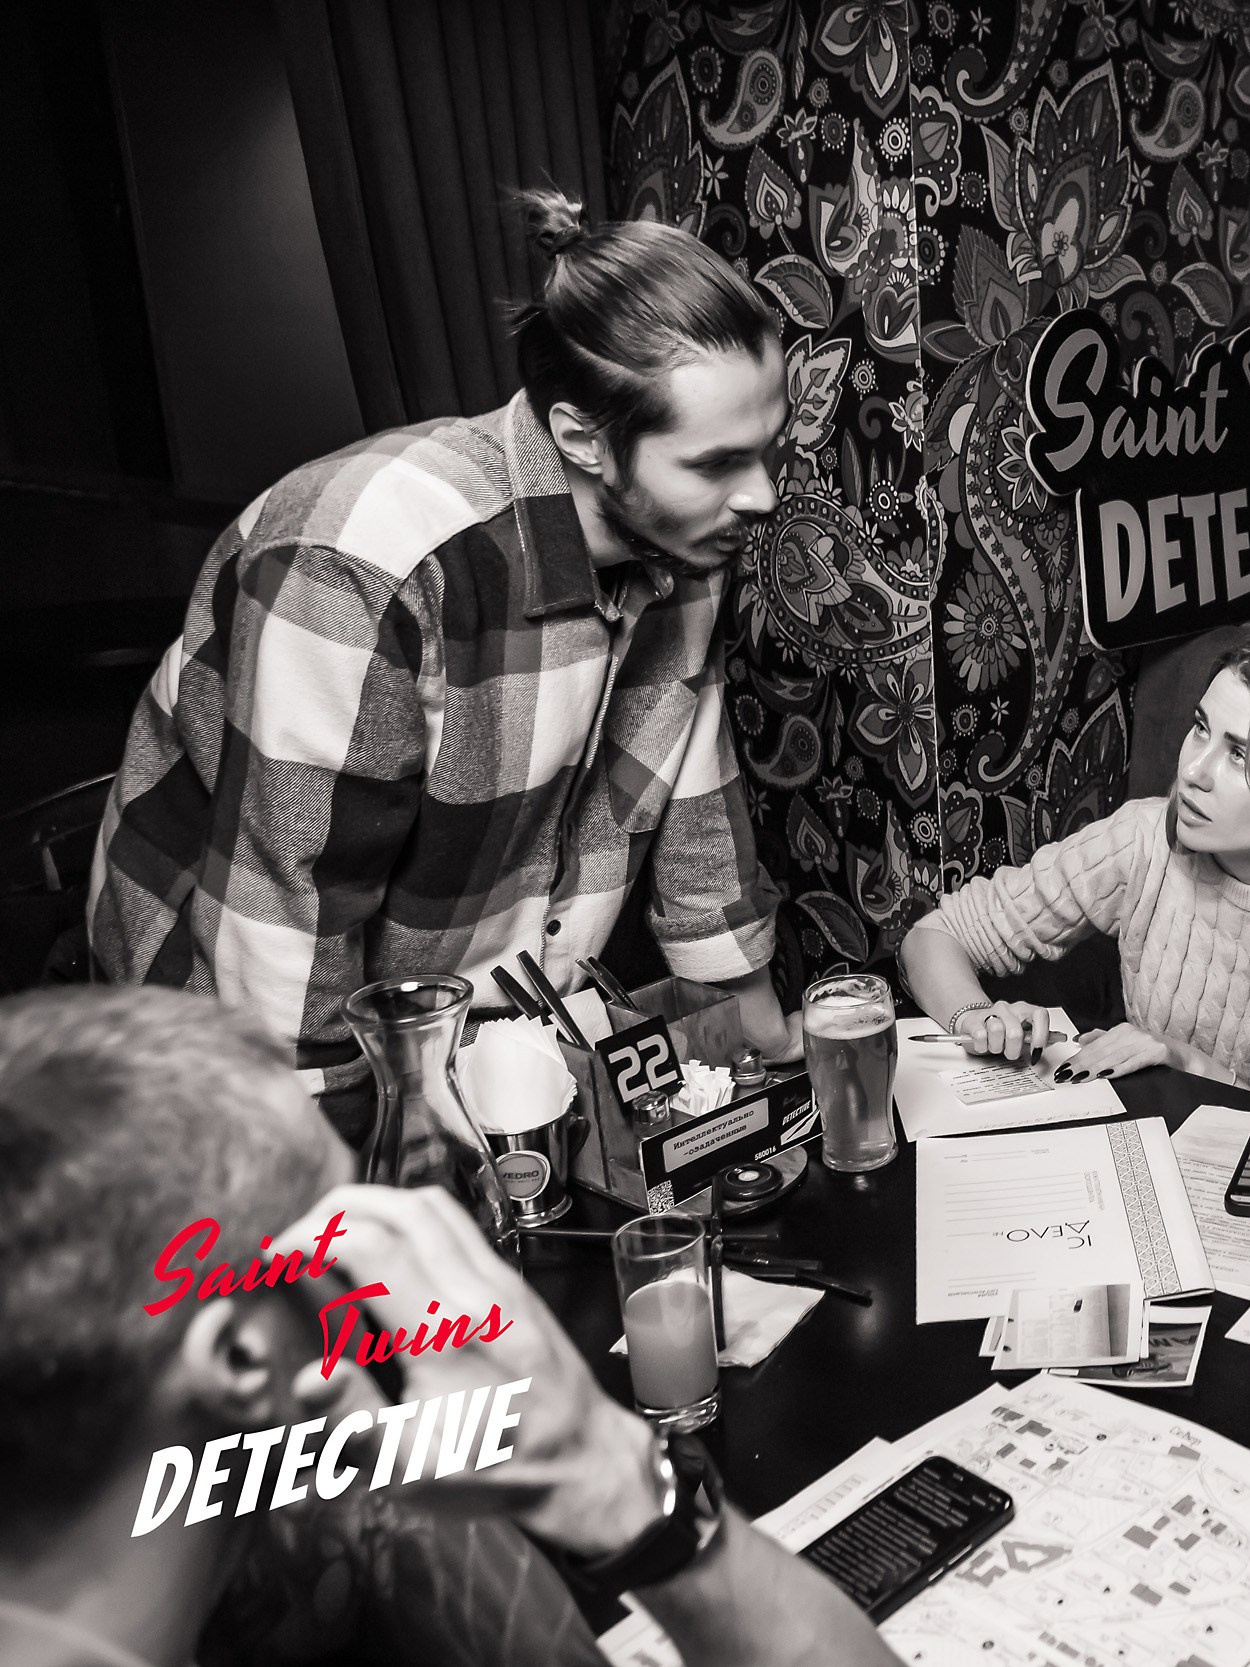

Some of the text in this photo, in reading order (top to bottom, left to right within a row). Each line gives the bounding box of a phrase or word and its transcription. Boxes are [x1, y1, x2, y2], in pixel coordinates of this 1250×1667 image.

[1045, 328, 1229, 473] Saint
[607, 1033, 679, 1104] 22
[673, 1110, 755, 1151] Интеллектуально
